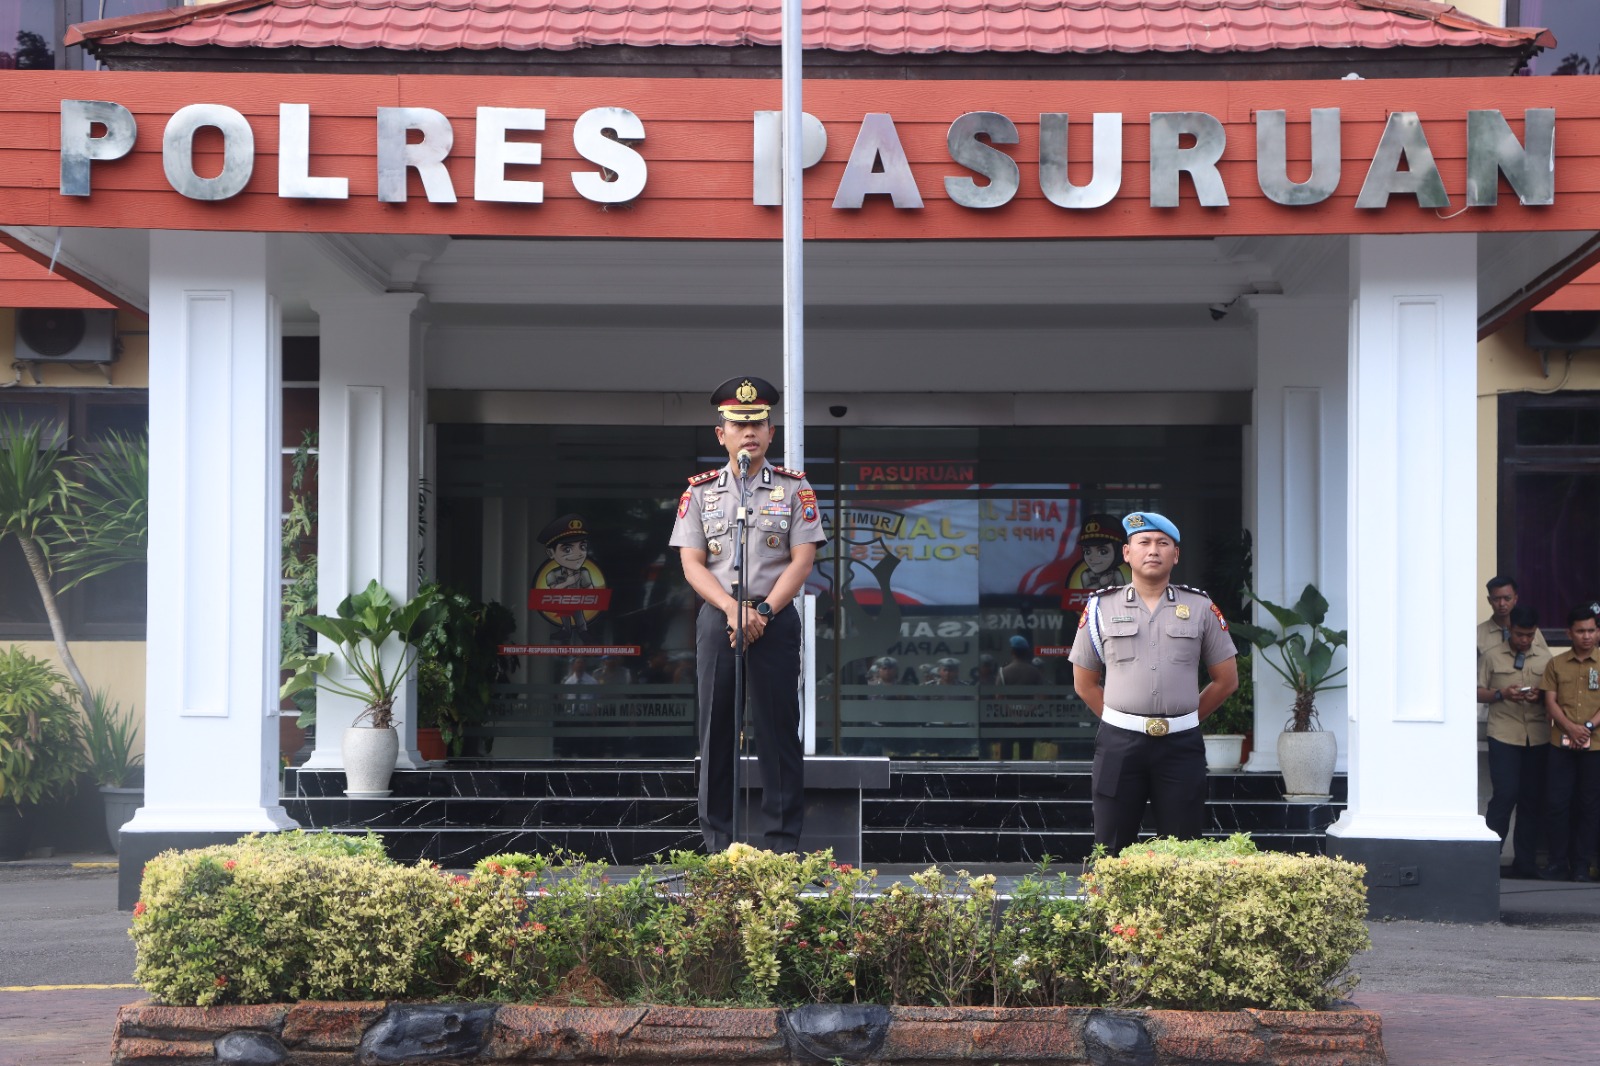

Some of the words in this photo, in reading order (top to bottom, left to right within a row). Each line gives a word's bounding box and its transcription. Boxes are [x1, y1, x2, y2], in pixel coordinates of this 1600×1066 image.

[60, 99, 647, 203] POLRES
[753, 107, 1556, 210] PASURUAN
[858, 466, 975, 482] PASURUAN
[842, 511, 892, 530] TIMUR
[541, 594, 599, 605] PRESISI
[619, 703, 687, 717] MASYARAKAT
